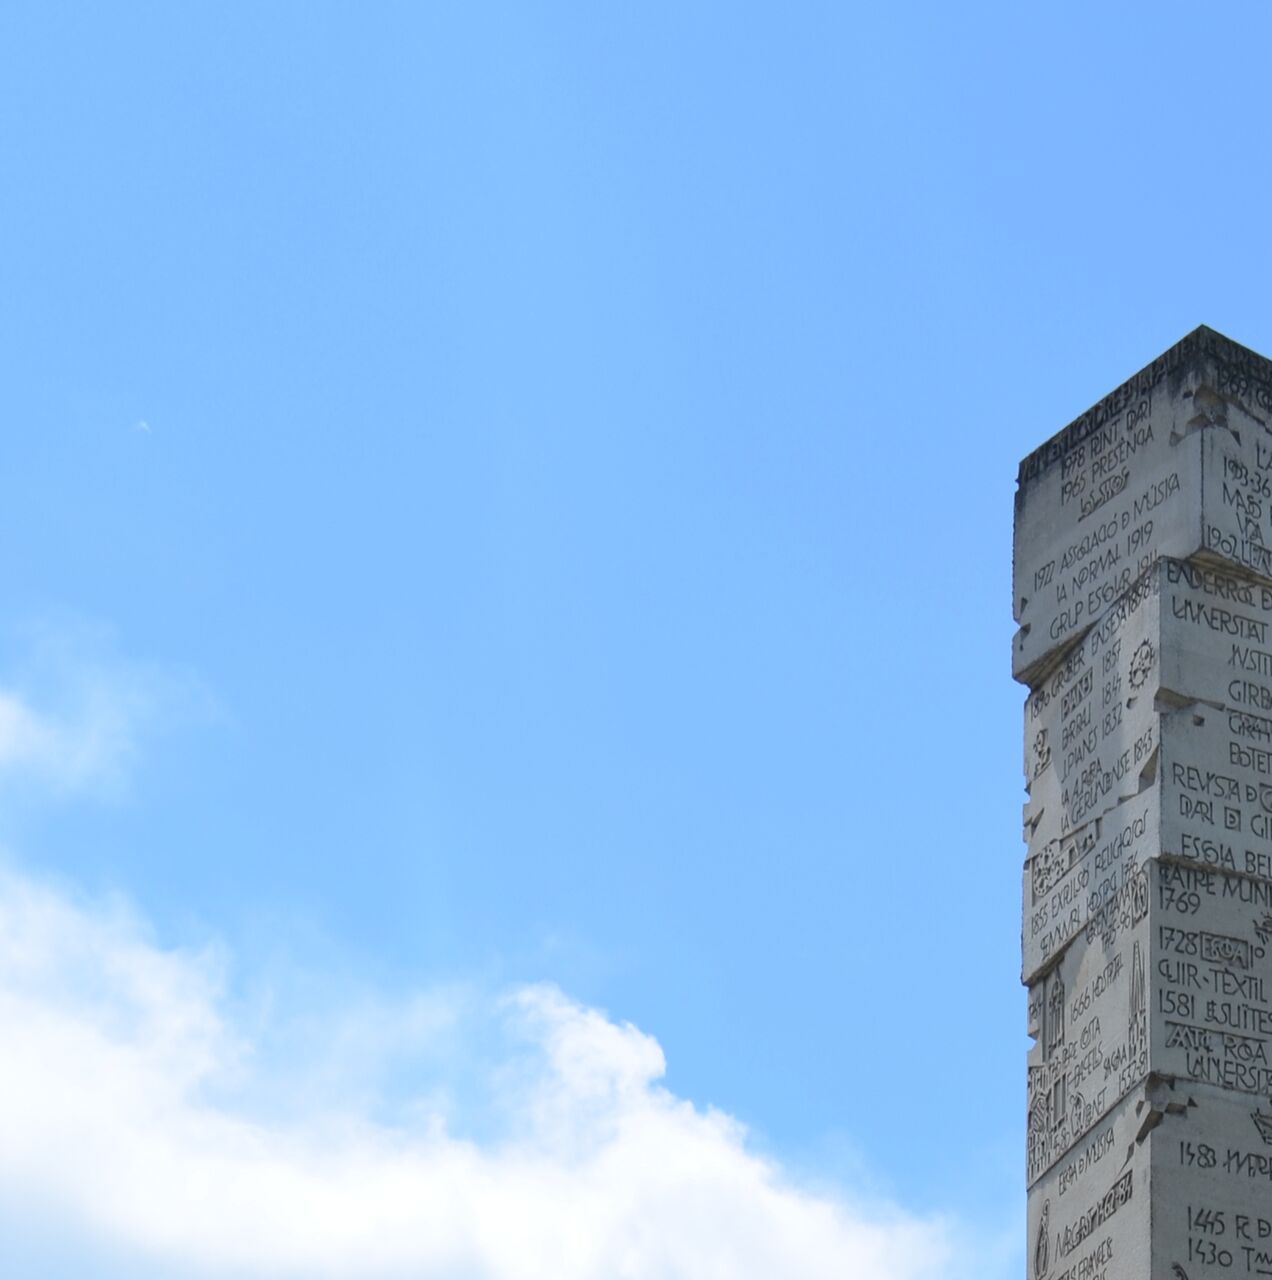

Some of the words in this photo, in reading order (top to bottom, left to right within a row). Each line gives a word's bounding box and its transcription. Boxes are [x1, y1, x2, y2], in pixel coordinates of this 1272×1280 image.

[1158, 885, 1200, 915] 1769
[1158, 925, 1200, 956] 1728
[1158, 988, 1196, 1019] 1581
